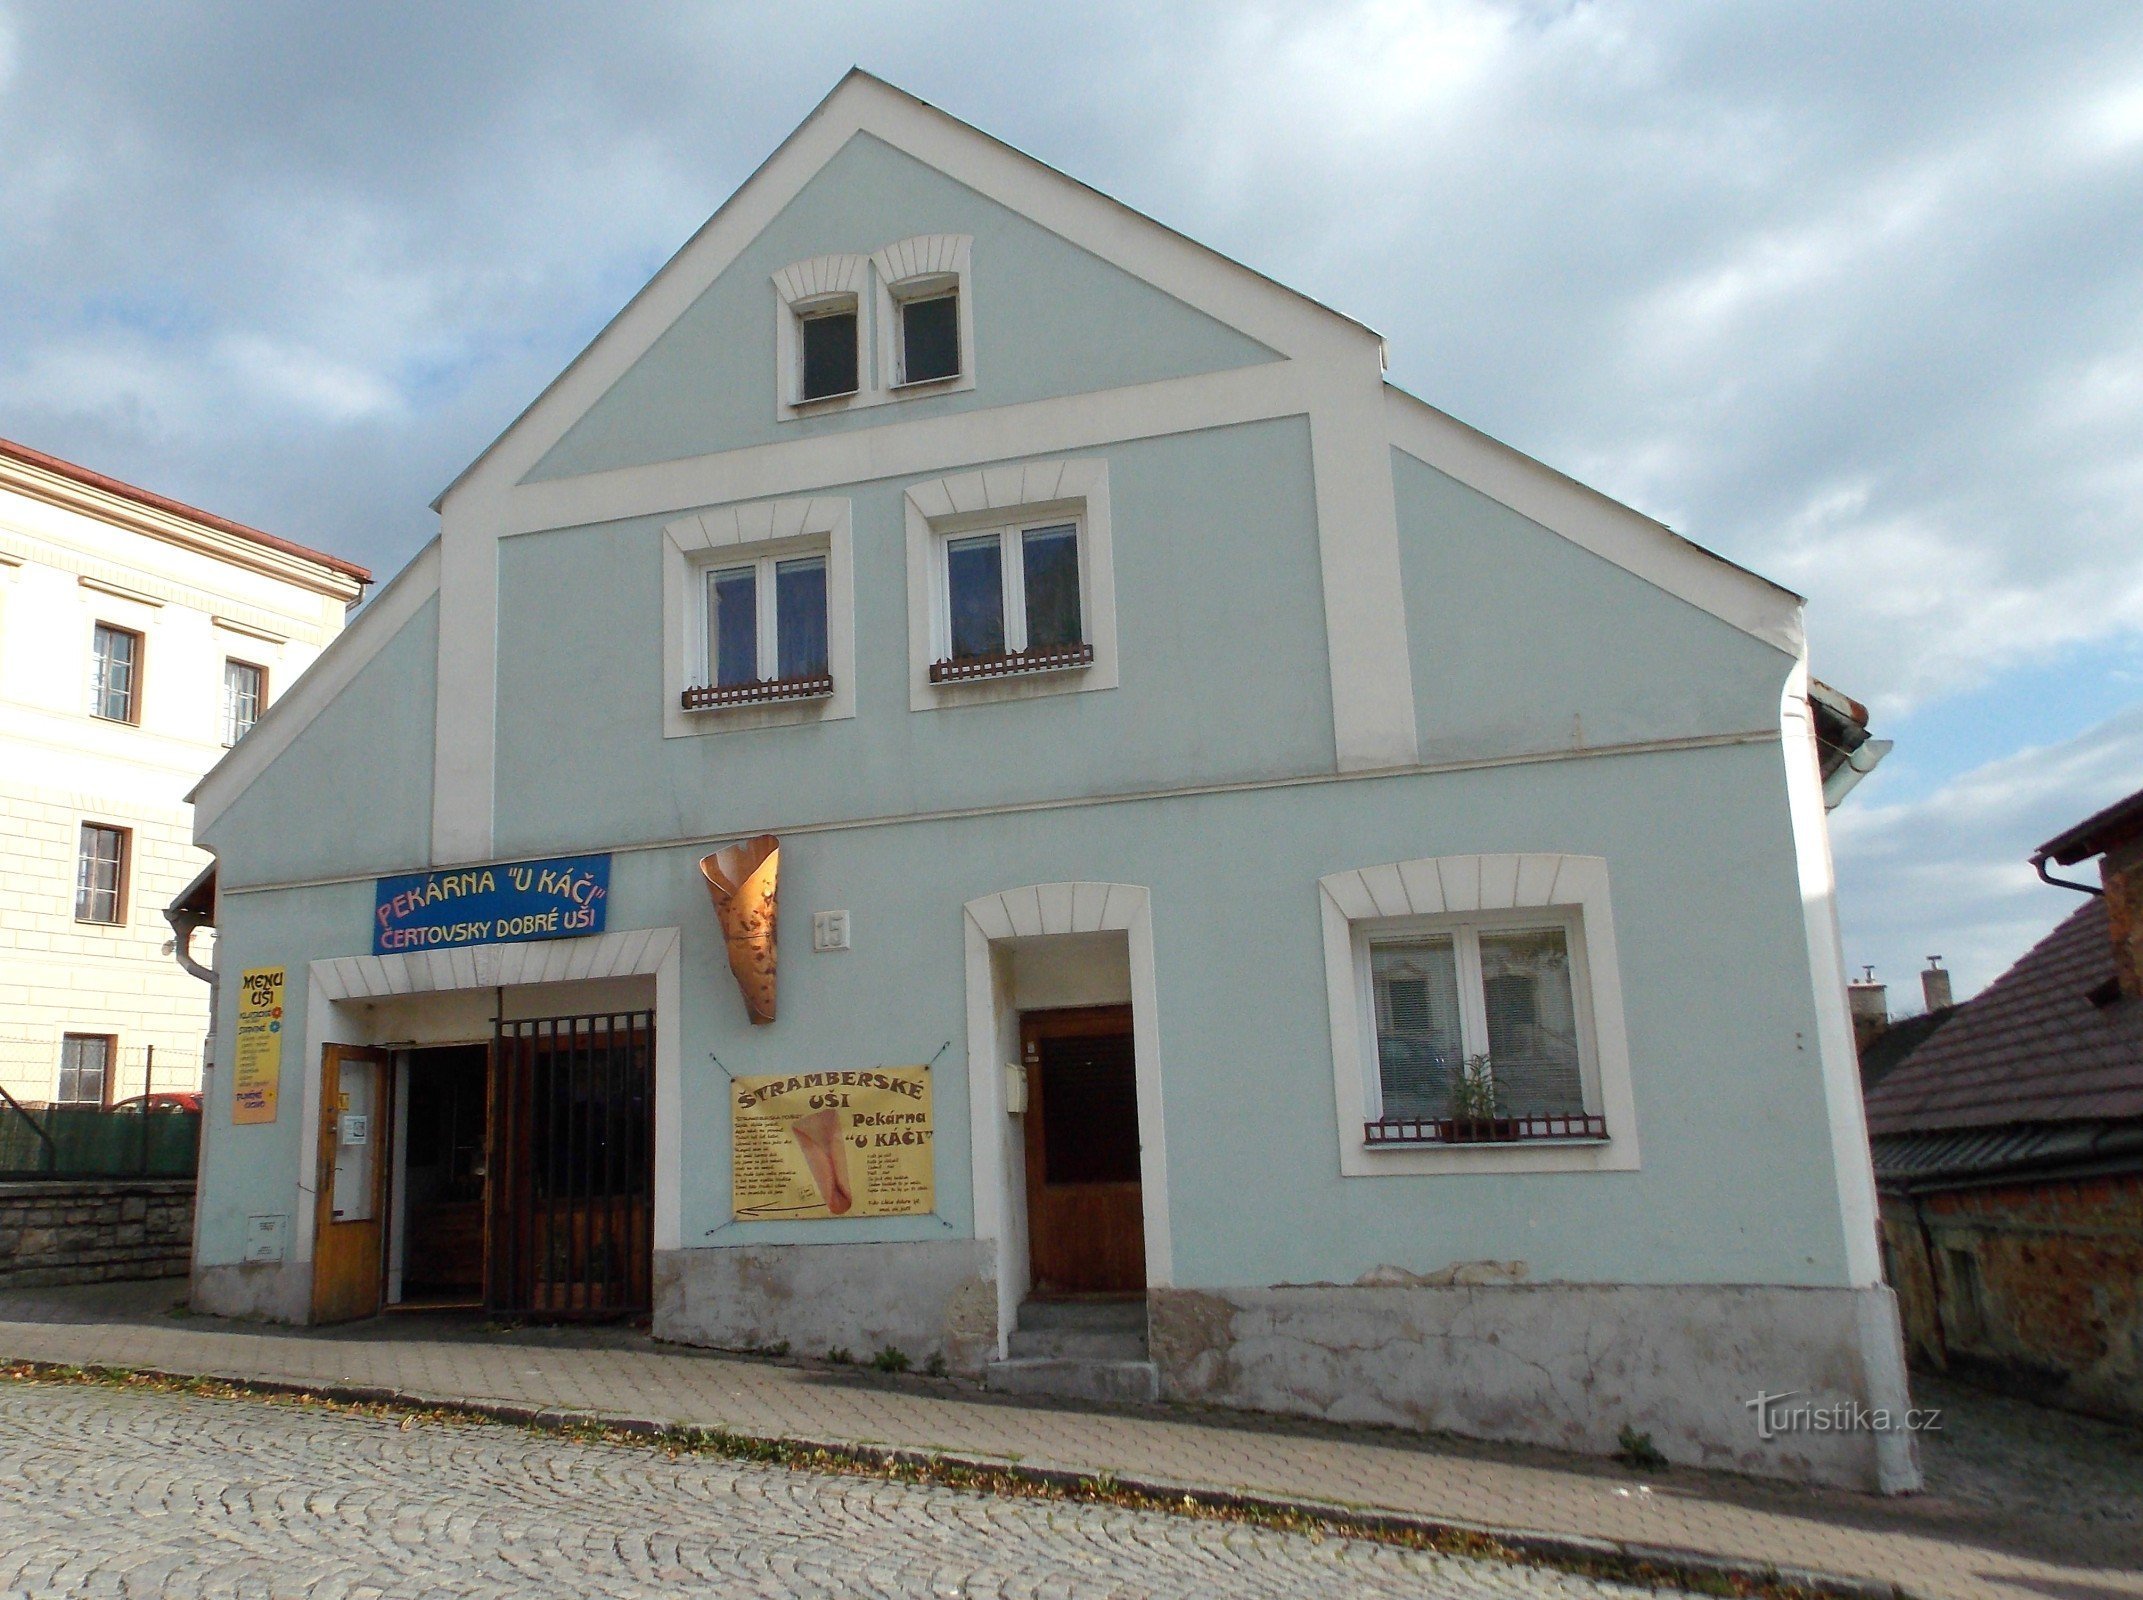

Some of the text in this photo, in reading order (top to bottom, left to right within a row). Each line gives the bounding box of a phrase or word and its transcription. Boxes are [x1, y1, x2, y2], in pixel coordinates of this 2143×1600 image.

[376, 870, 495, 927] PEKÁRNA
[380, 905, 595, 948] ČERTOVSKY DOBRÉ UŠI
[243, 972, 284, 991] MENU
[251, 988, 274, 1007] UŠI
[738, 1071, 924, 1109] ŠTRAMBERSKÉ
[809, 1089, 851, 1109] UŠI
[852, 1110, 926, 1127] Pekárna
